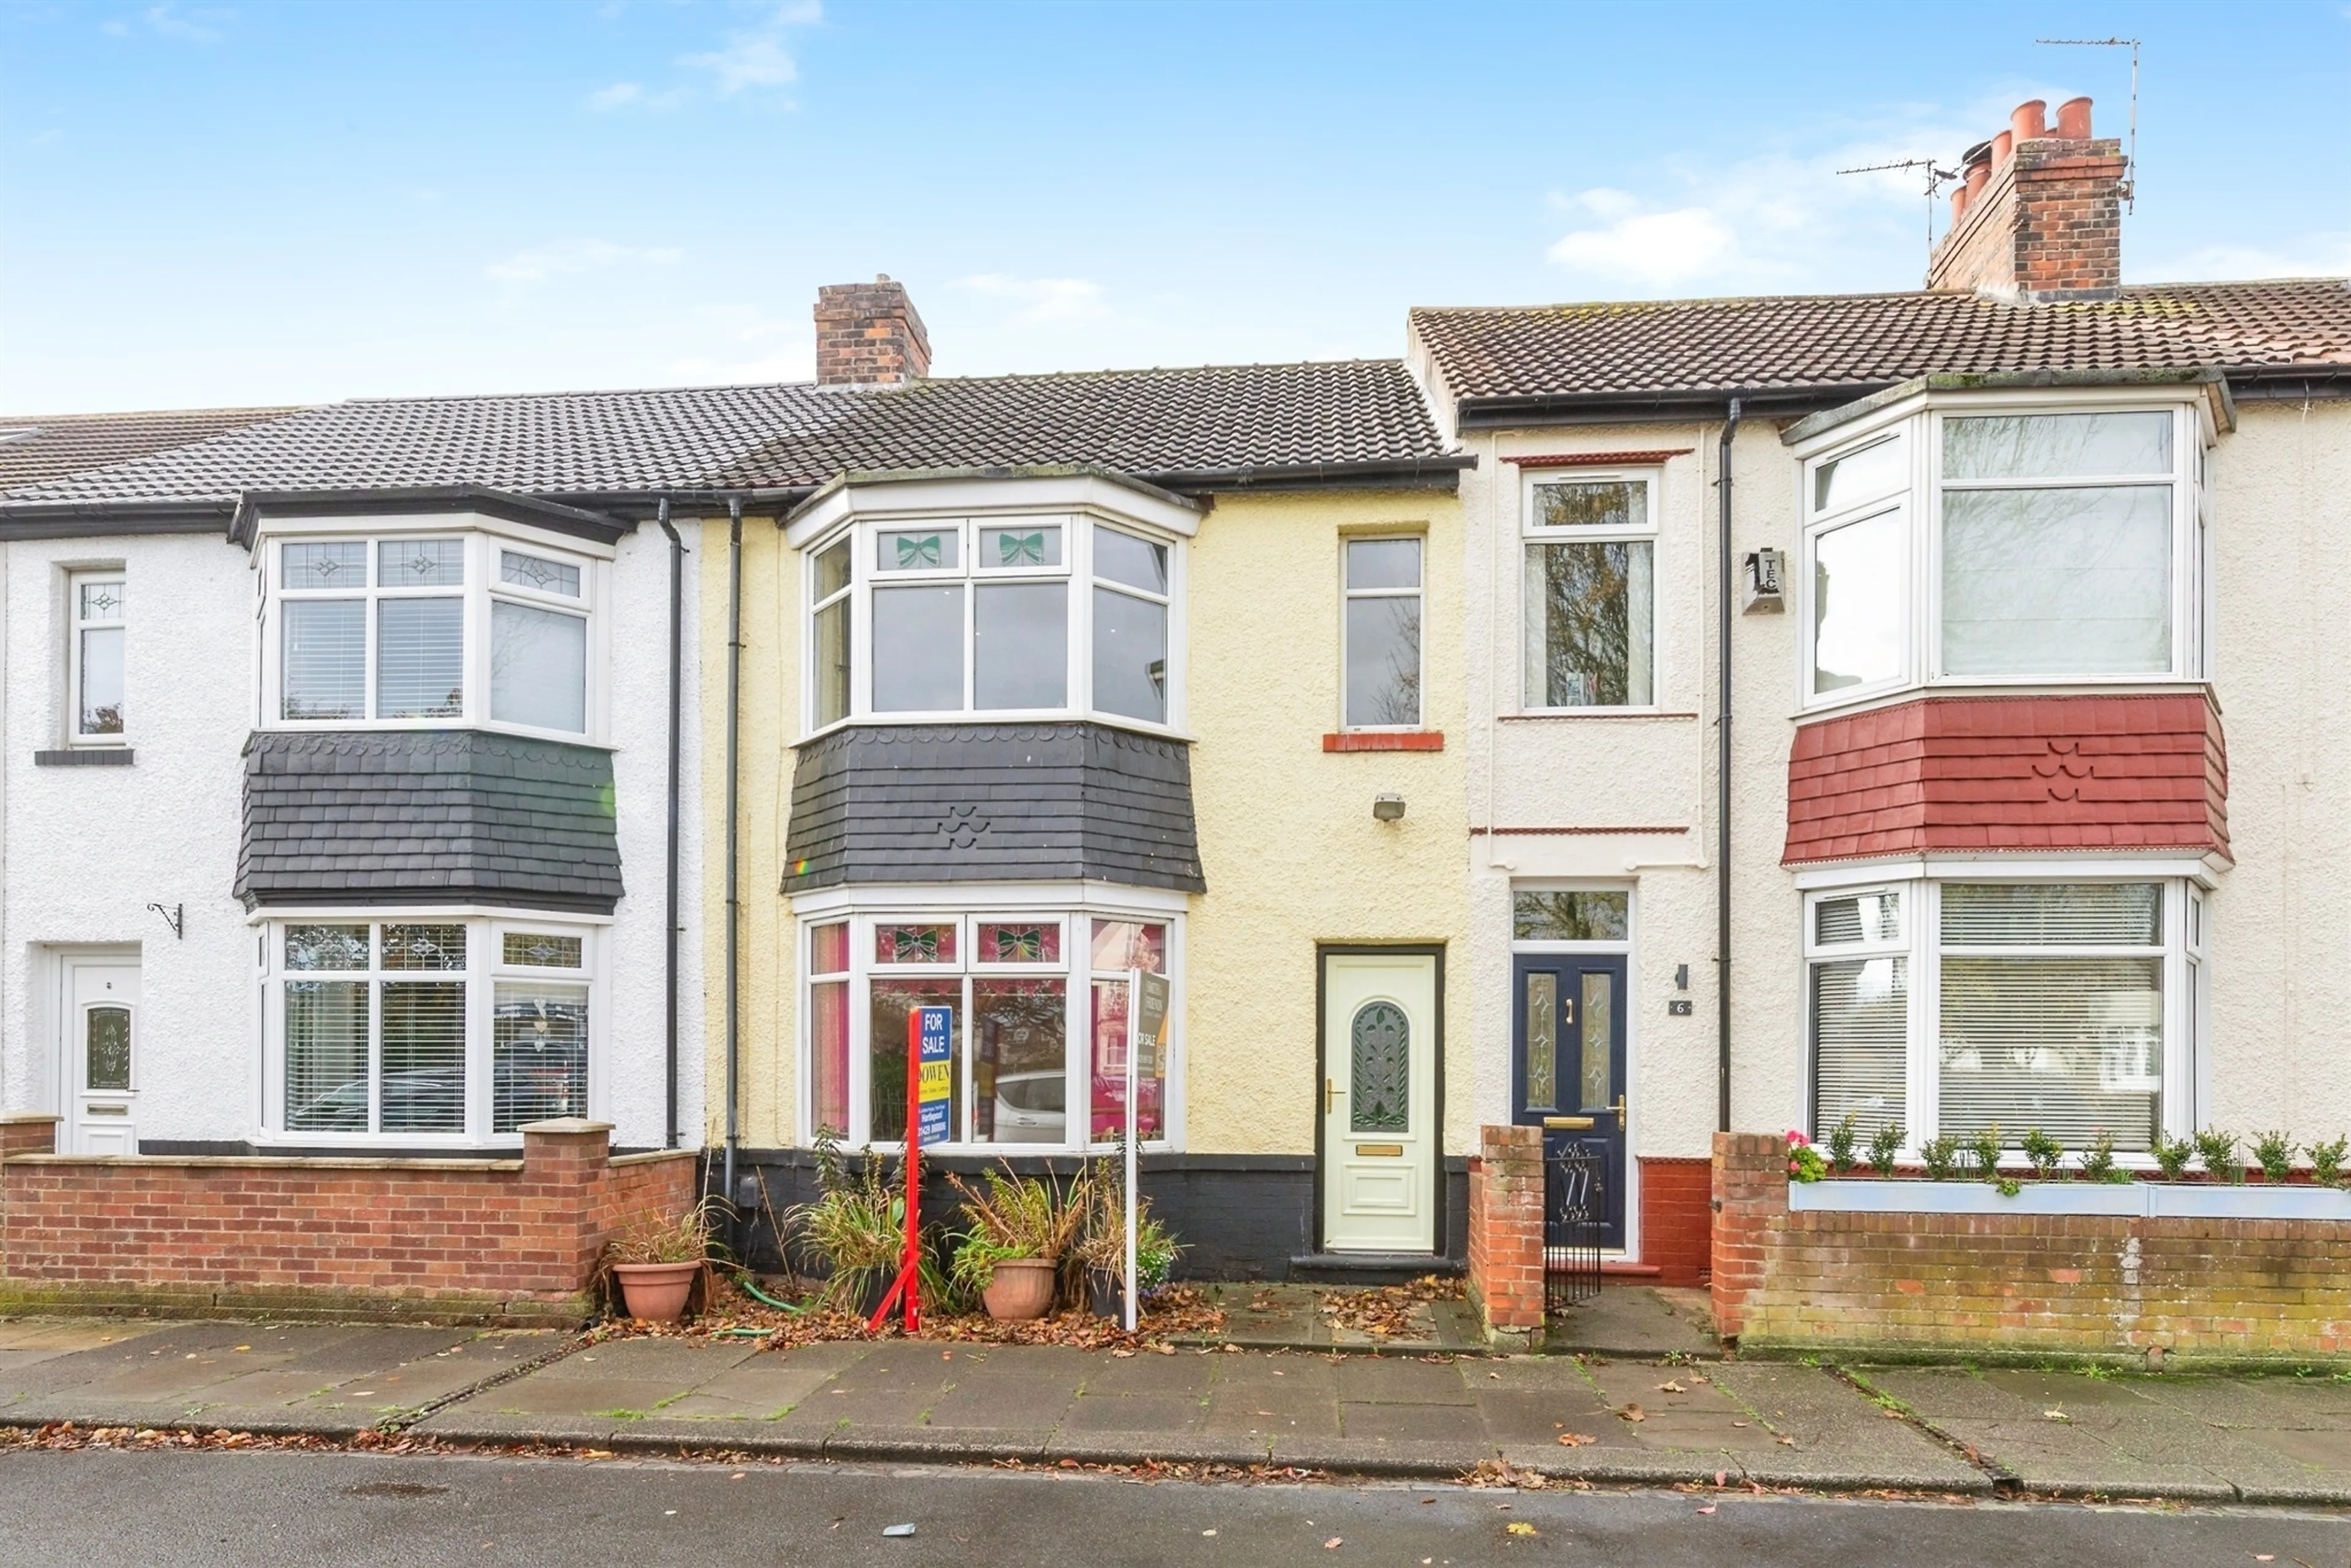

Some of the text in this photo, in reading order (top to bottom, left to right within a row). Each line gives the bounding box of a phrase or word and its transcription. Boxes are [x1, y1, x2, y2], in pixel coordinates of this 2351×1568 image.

[1677, 1003, 1684, 1013] 6
[925, 1013, 943, 1031] FOR
[923, 1036, 945, 1054] SALE
[1144, 1033, 1156, 1046] SALE
